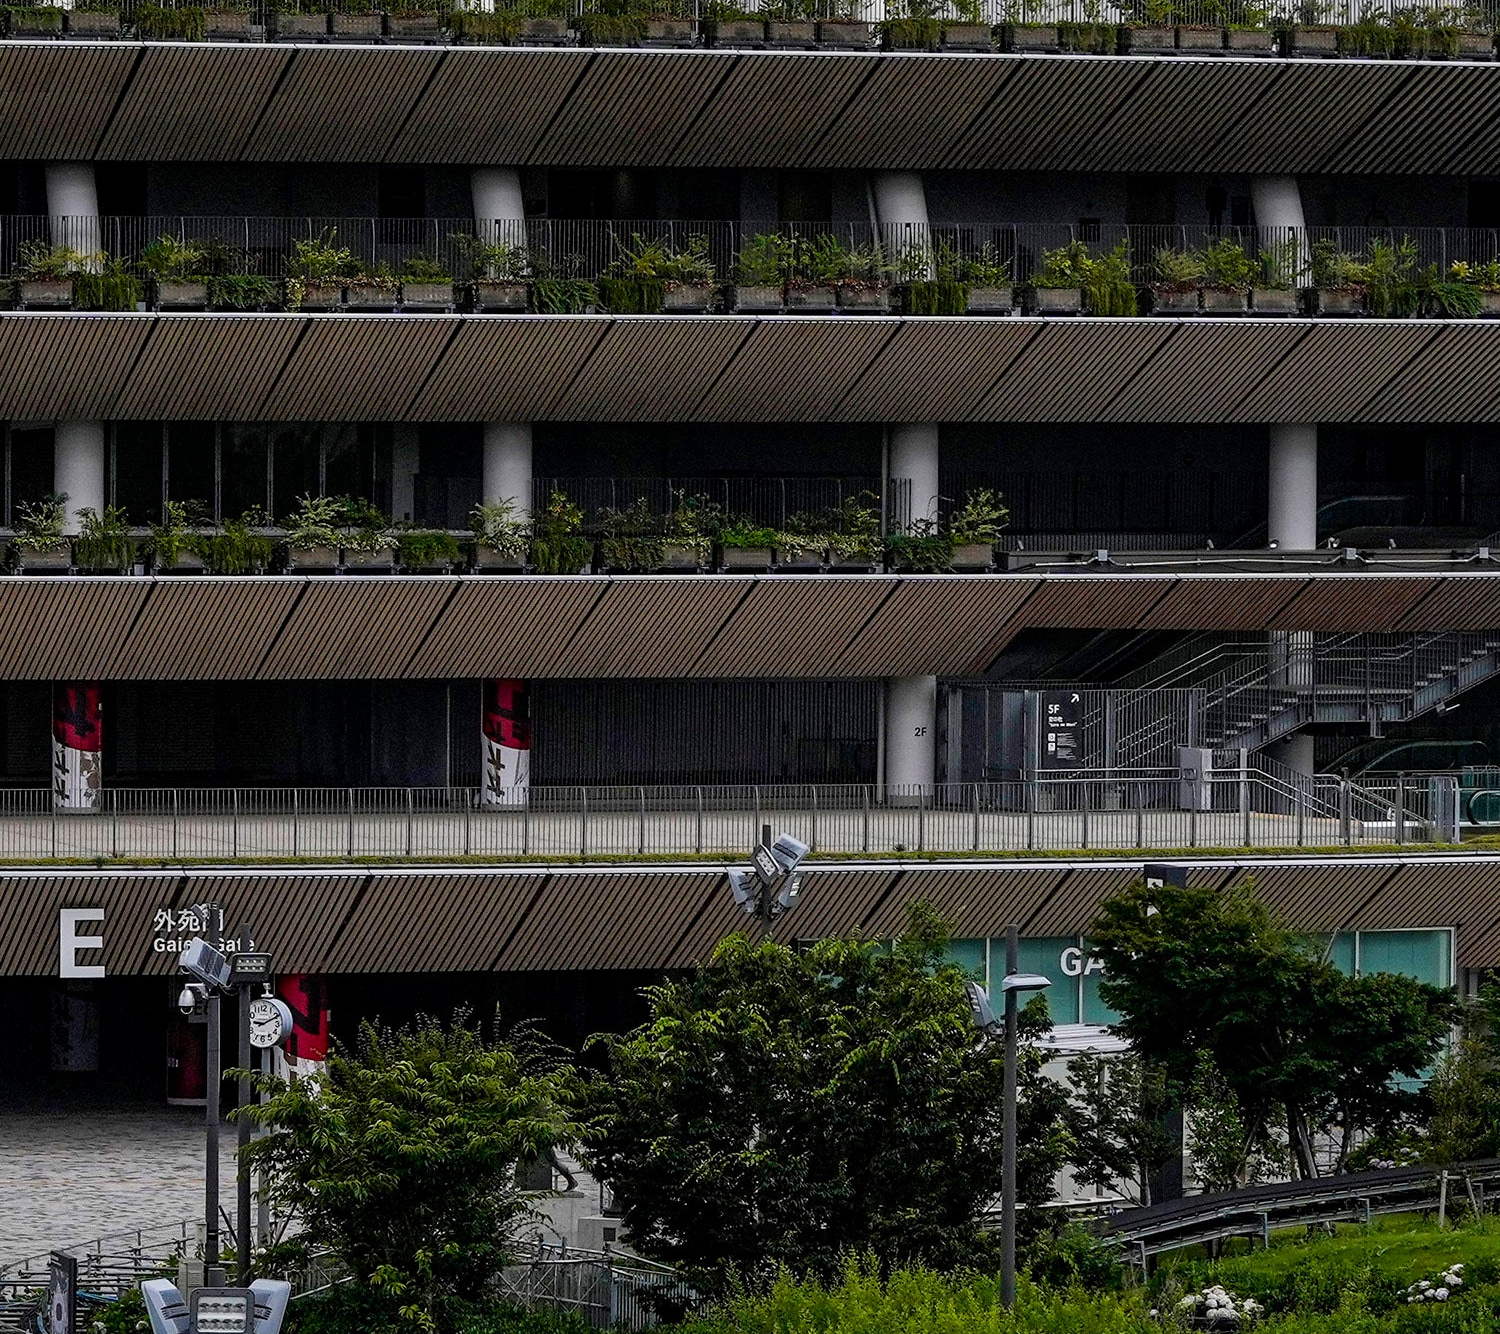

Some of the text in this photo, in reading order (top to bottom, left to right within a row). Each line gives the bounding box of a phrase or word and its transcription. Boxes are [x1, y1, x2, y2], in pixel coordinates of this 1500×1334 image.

[1048, 704, 1060, 714] 5F
[914, 727, 927, 737] 2F
[60, 908, 105, 978] E
